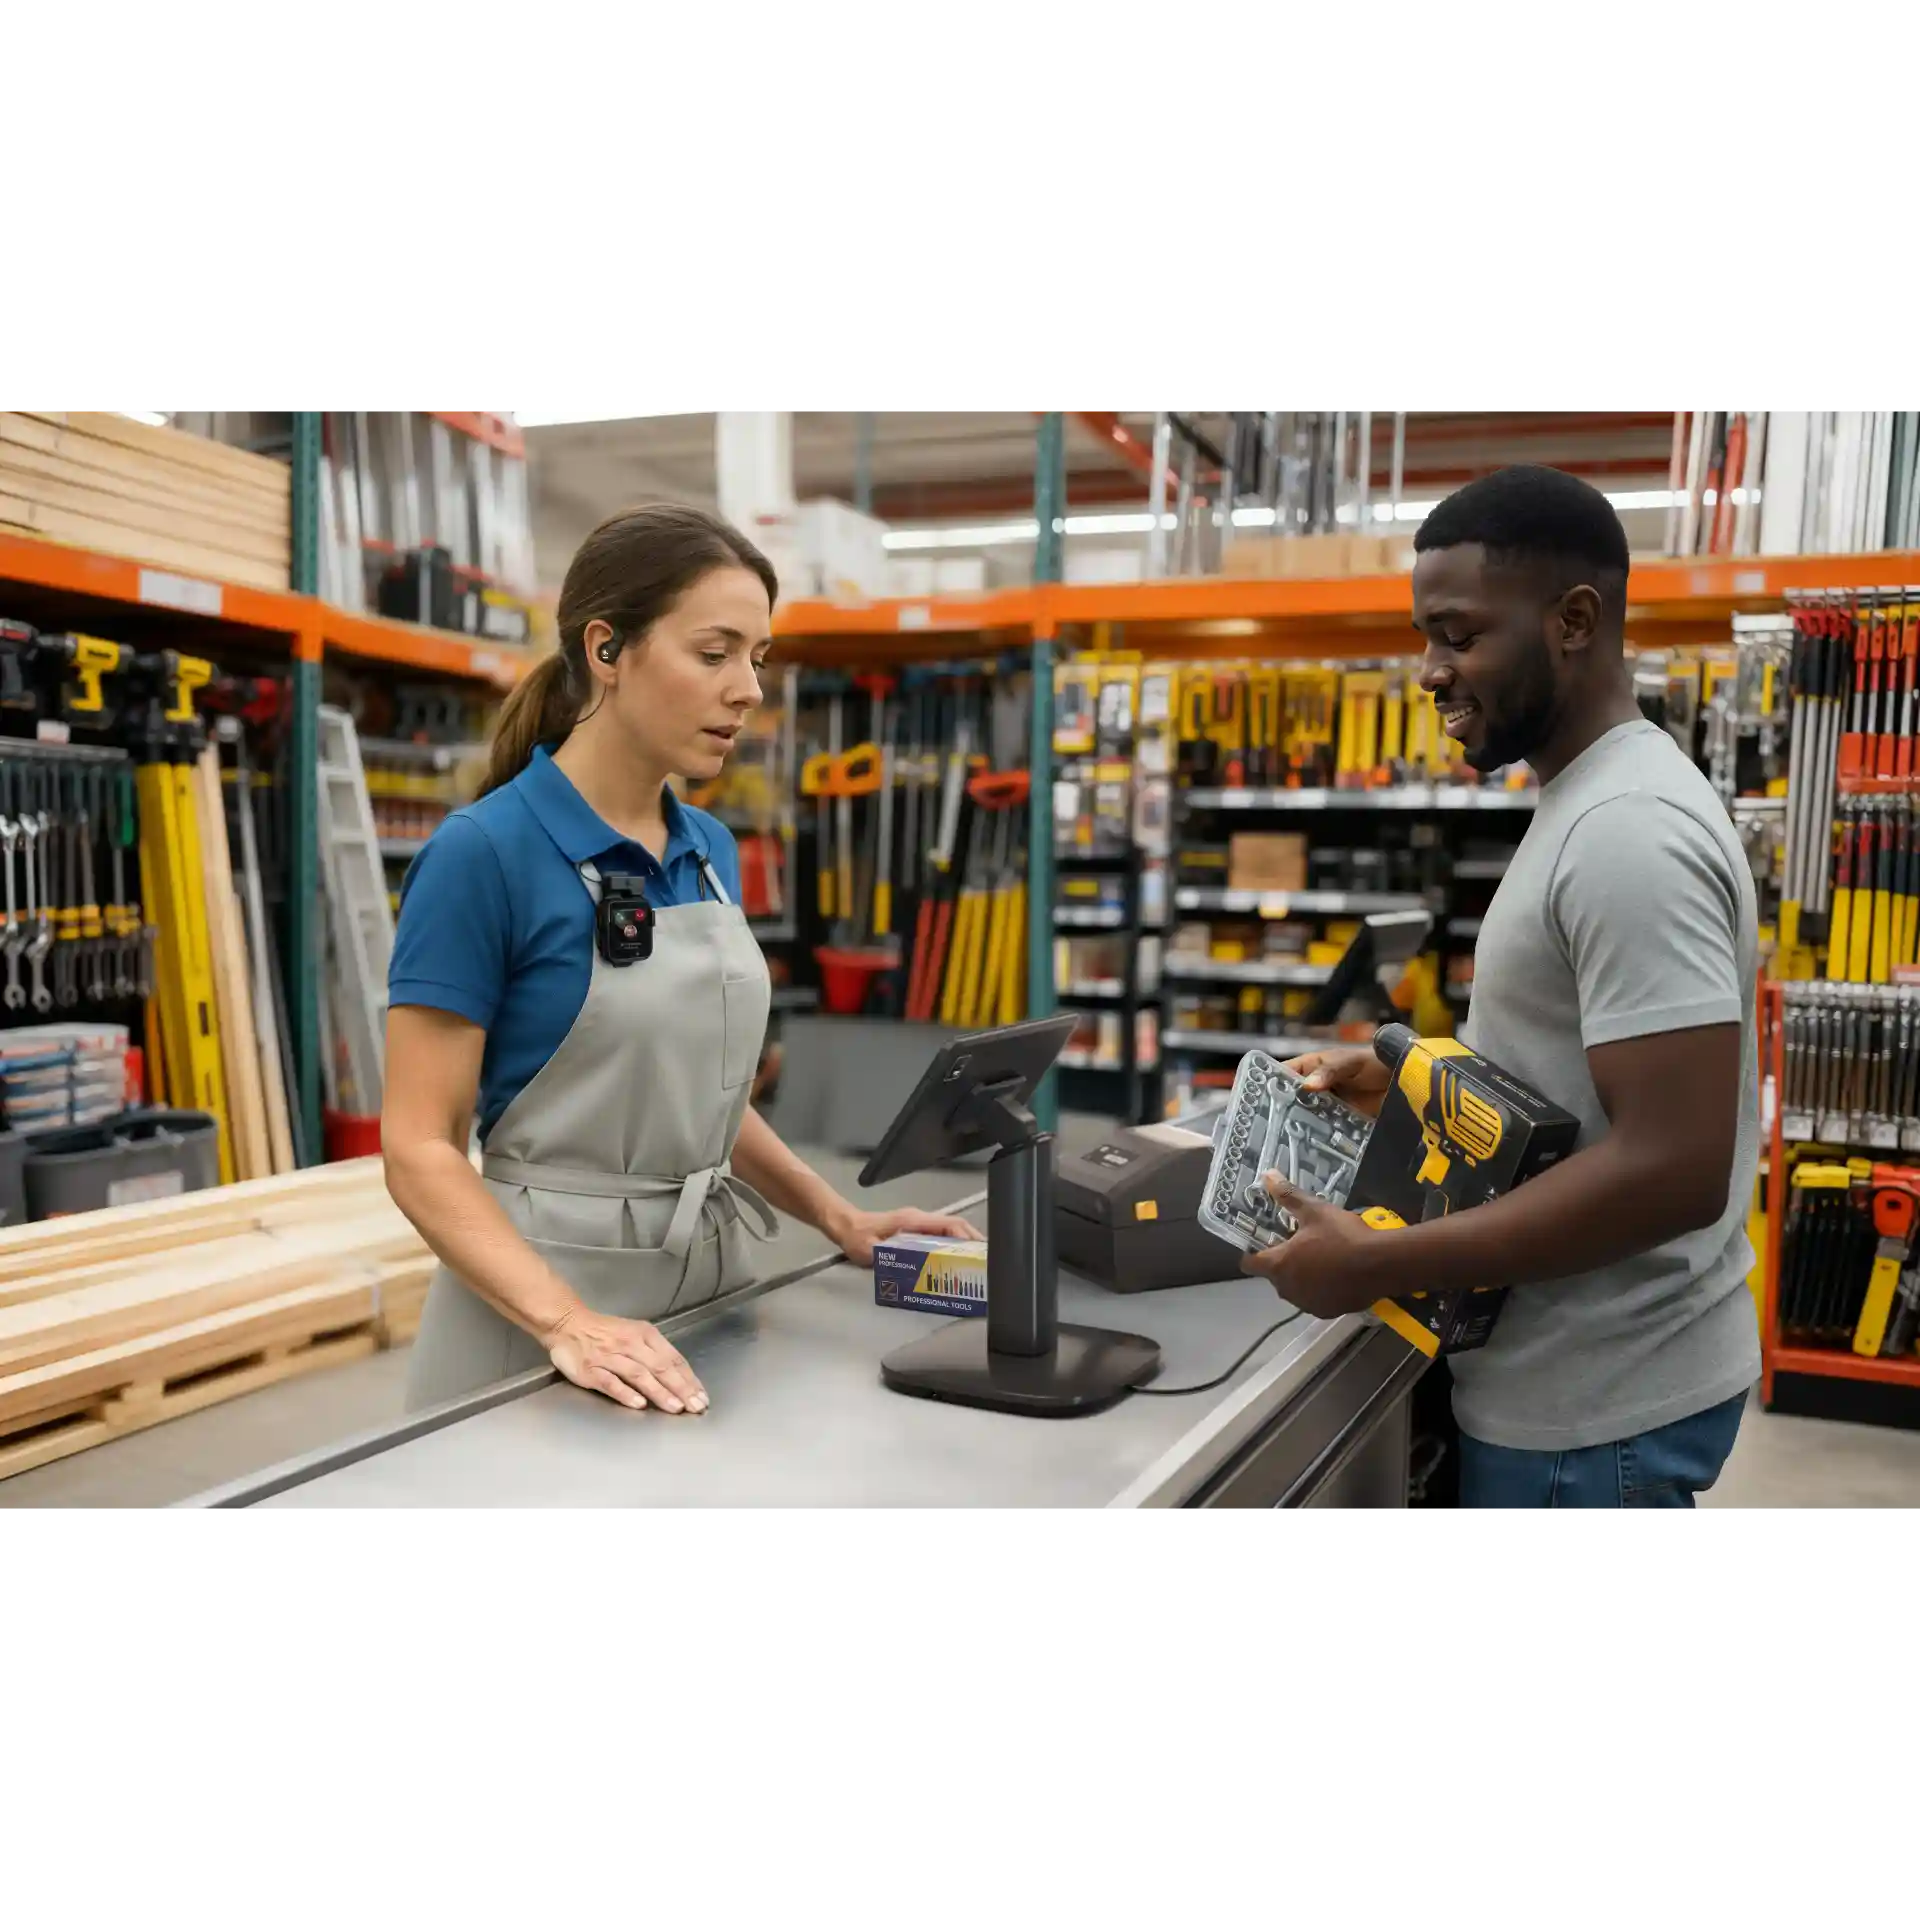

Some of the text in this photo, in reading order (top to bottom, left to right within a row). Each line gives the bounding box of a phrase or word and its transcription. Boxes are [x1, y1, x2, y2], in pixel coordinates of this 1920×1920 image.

[878, 1251, 896, 1261] NEW
[878, 1260, 917, 1271] PROFESSIONAL
[903, 1295, 972, 1311] PROFESSIONAL TOOLS
